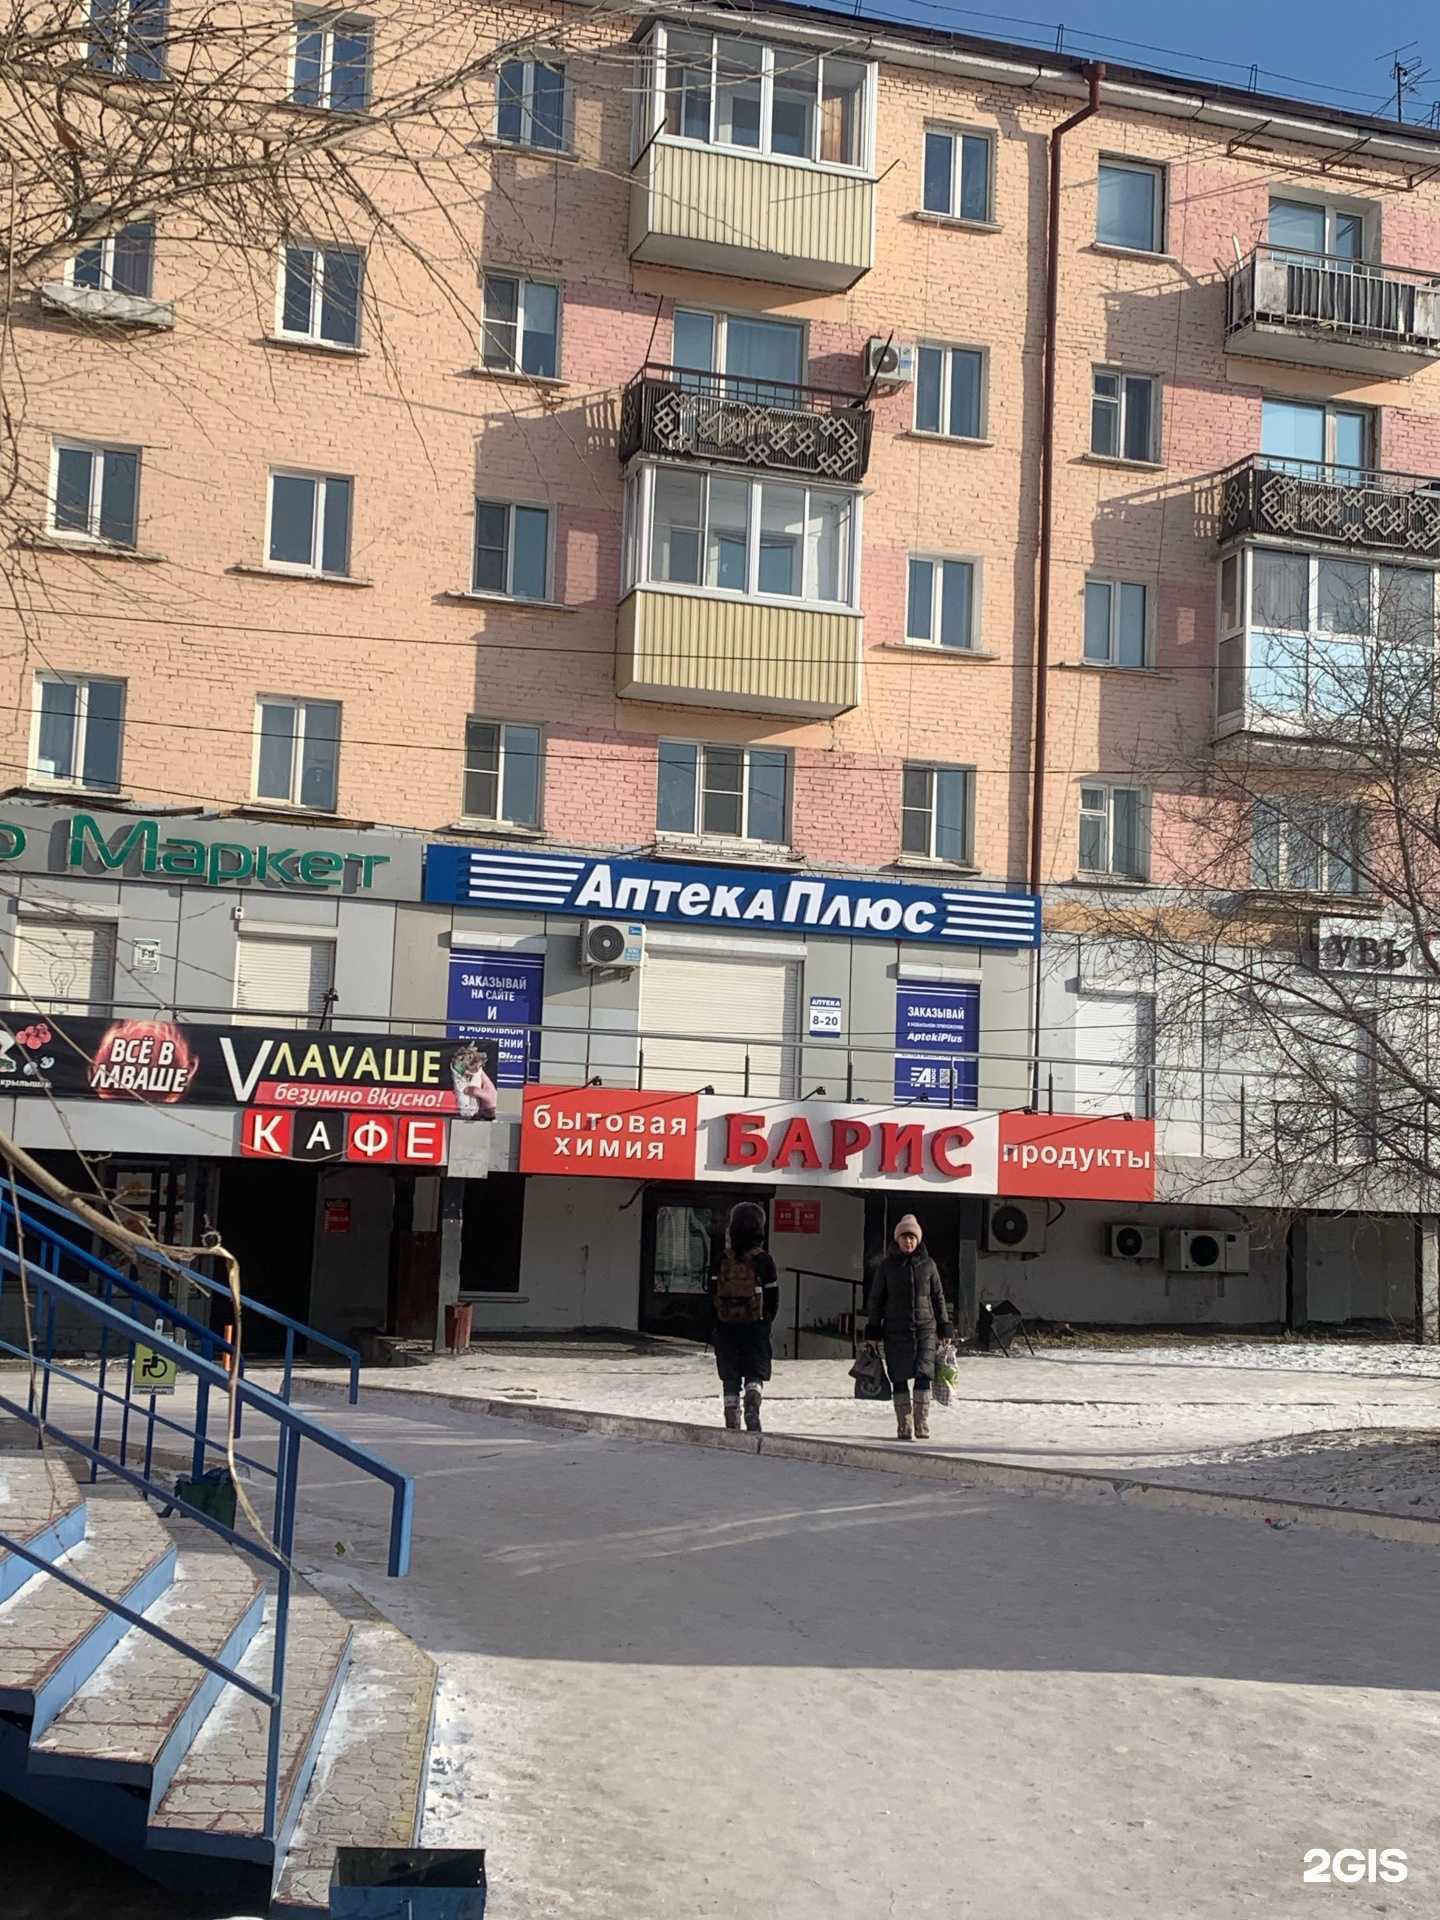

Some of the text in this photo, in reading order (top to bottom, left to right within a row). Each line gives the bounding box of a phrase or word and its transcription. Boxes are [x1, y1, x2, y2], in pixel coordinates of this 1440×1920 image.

[70, 814, 391, 888] Маркет
[461, 975, 527, 990] ЗАКАЗЫВАЙ
[471, 989, 516, 1001] НА САЙТЕ
[487, 1006, 498, 1020] И
[811, 998, 841, 1007] АПТЕКА
[907, 1006, 965, 1020] ЗАКАЗЫВАЙ
[812, 1015, 838, 1026] 8-20
[110, 1036, 176, 1066] ВСЁ В
[90, 1064, 188, 1092] ЛАВАШЕ
[274, 1081, 444, 1109] безумно вкусно!
[533, 1104, 687, 1136] бытовая
[253, 1115, 437, 1159] КАФЕ
[553, 1136, 664, 1160] химия
[723, 1113, 974, 1178] БАРИС
[1003, 1142, 1150, 1171] продукты
